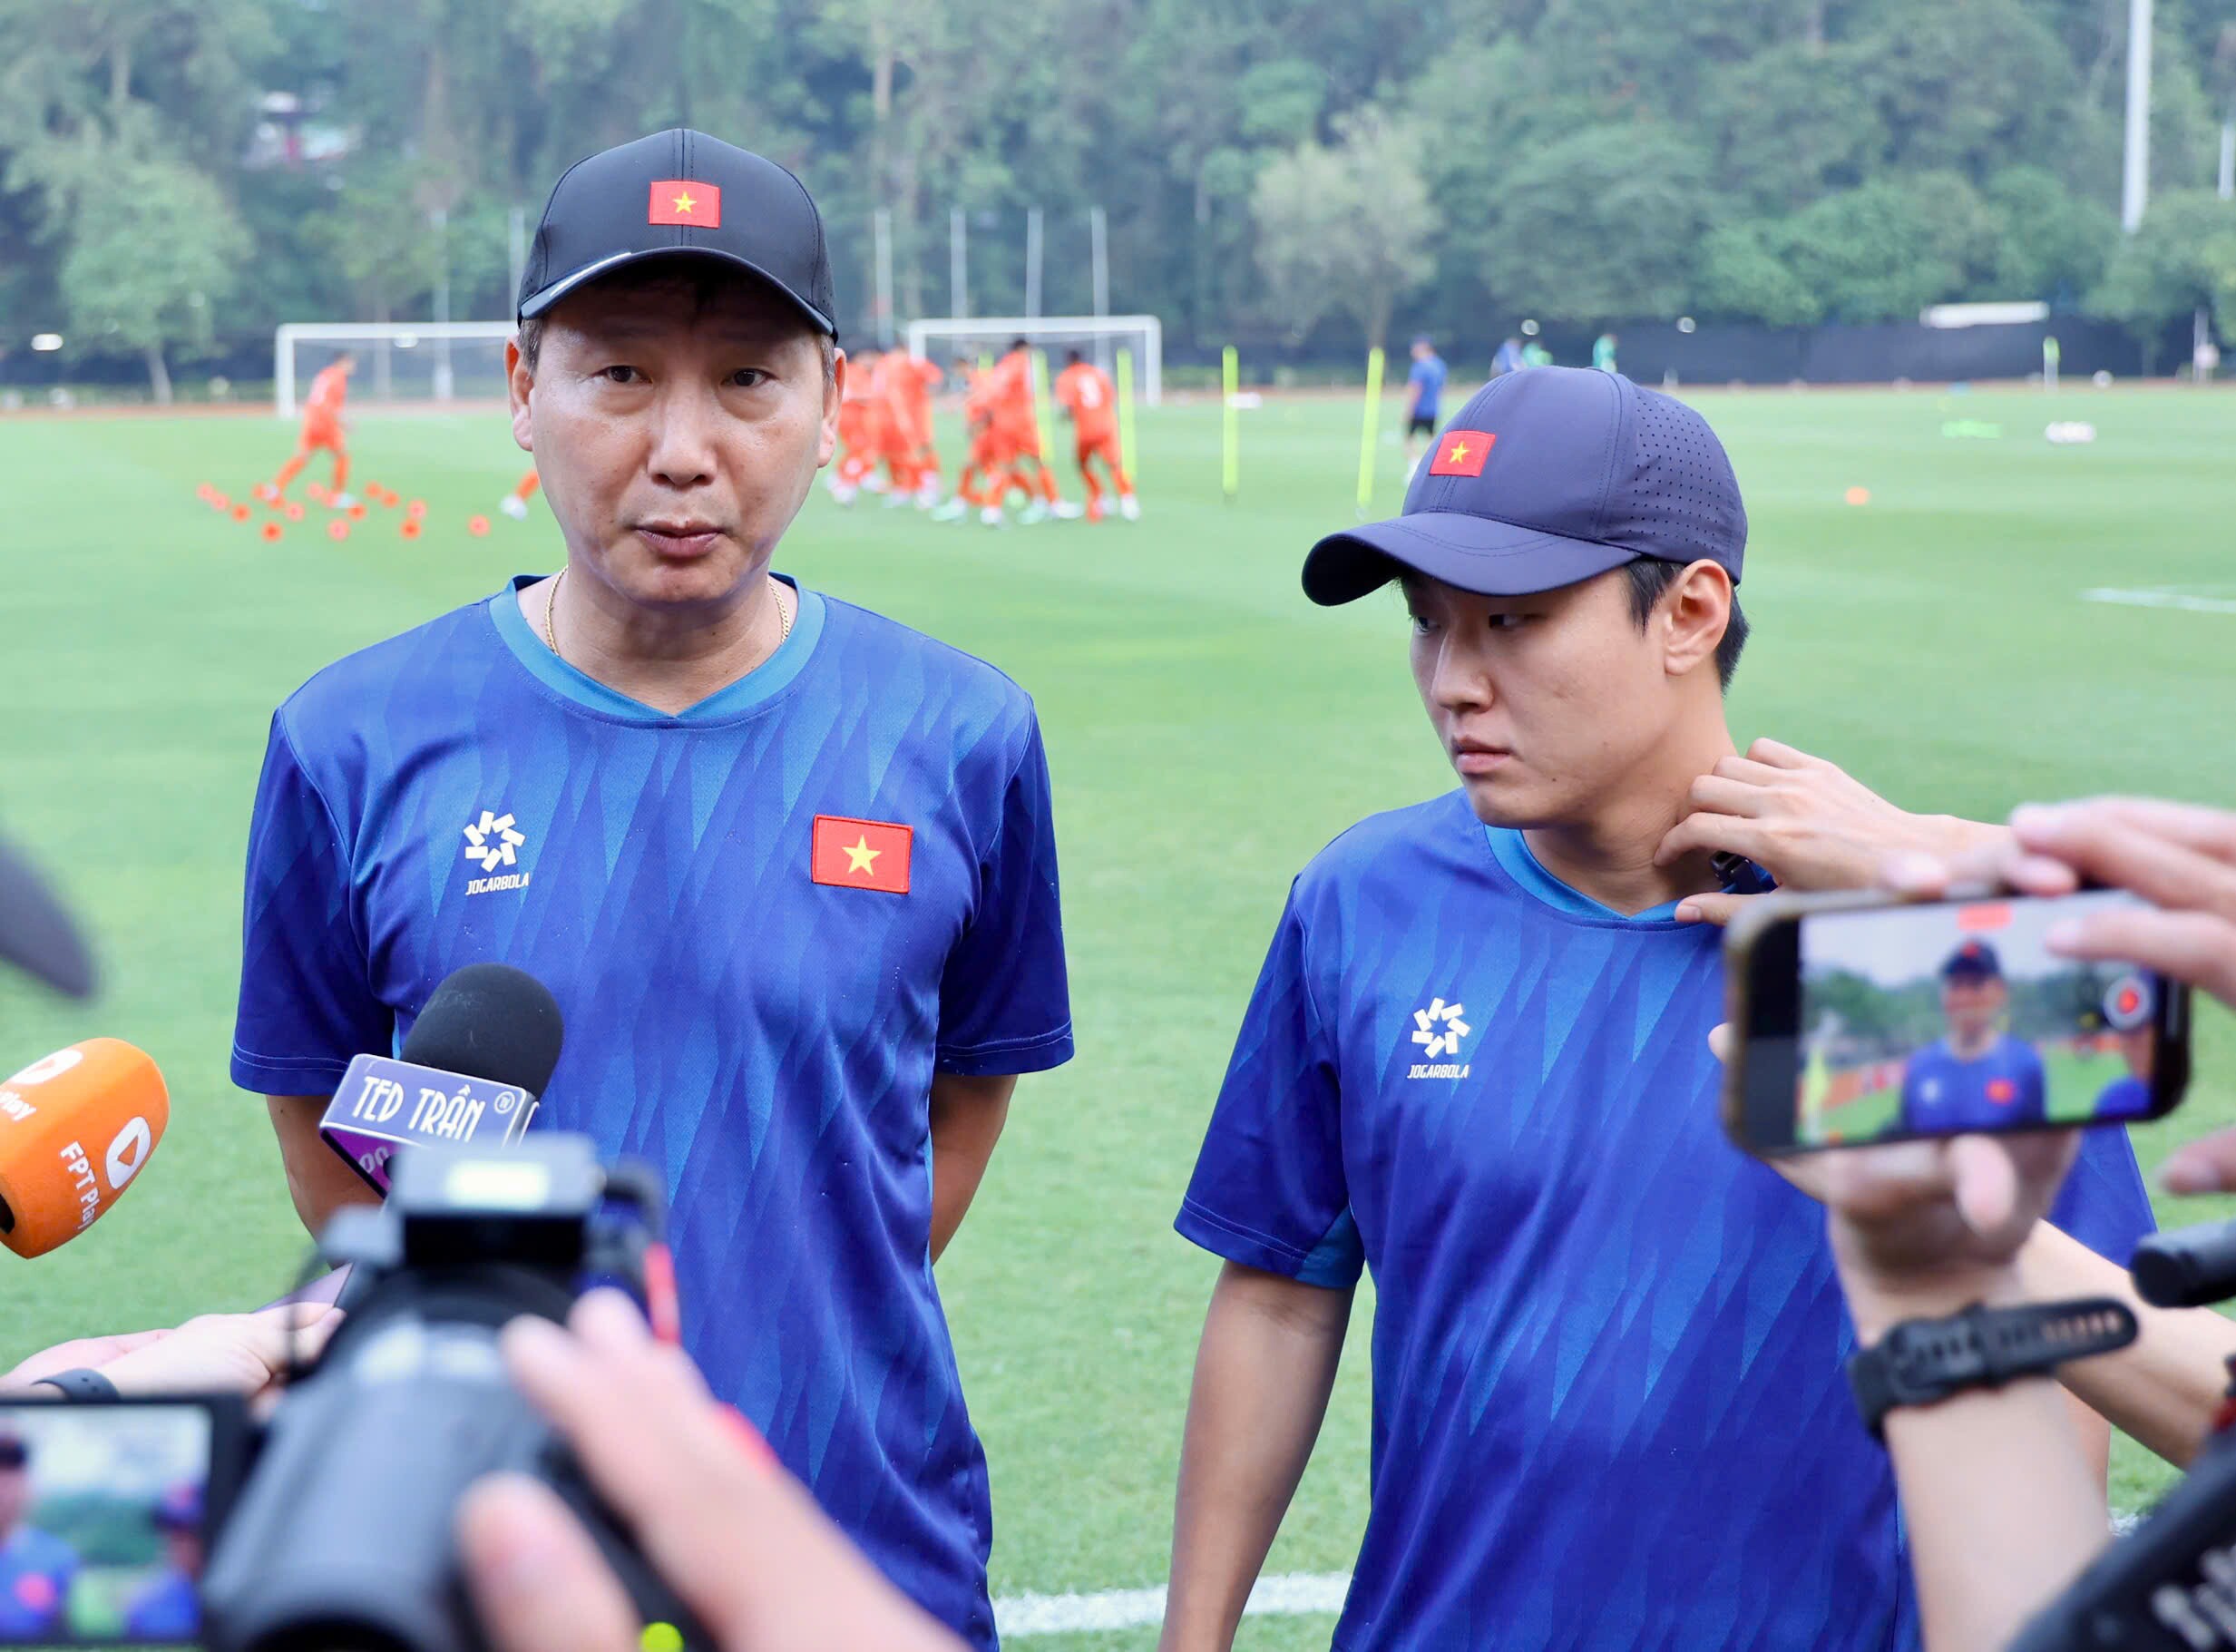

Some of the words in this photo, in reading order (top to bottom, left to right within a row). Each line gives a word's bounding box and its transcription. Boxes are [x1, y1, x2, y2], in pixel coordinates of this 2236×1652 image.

[464, 872, 530, 895] JOGARBOLA
[1407, 1064, 1470, 1079] JOGARBOLA
[352, 1076, 405, 1122] TED
[60, 1140, 96, 1191] FPT
